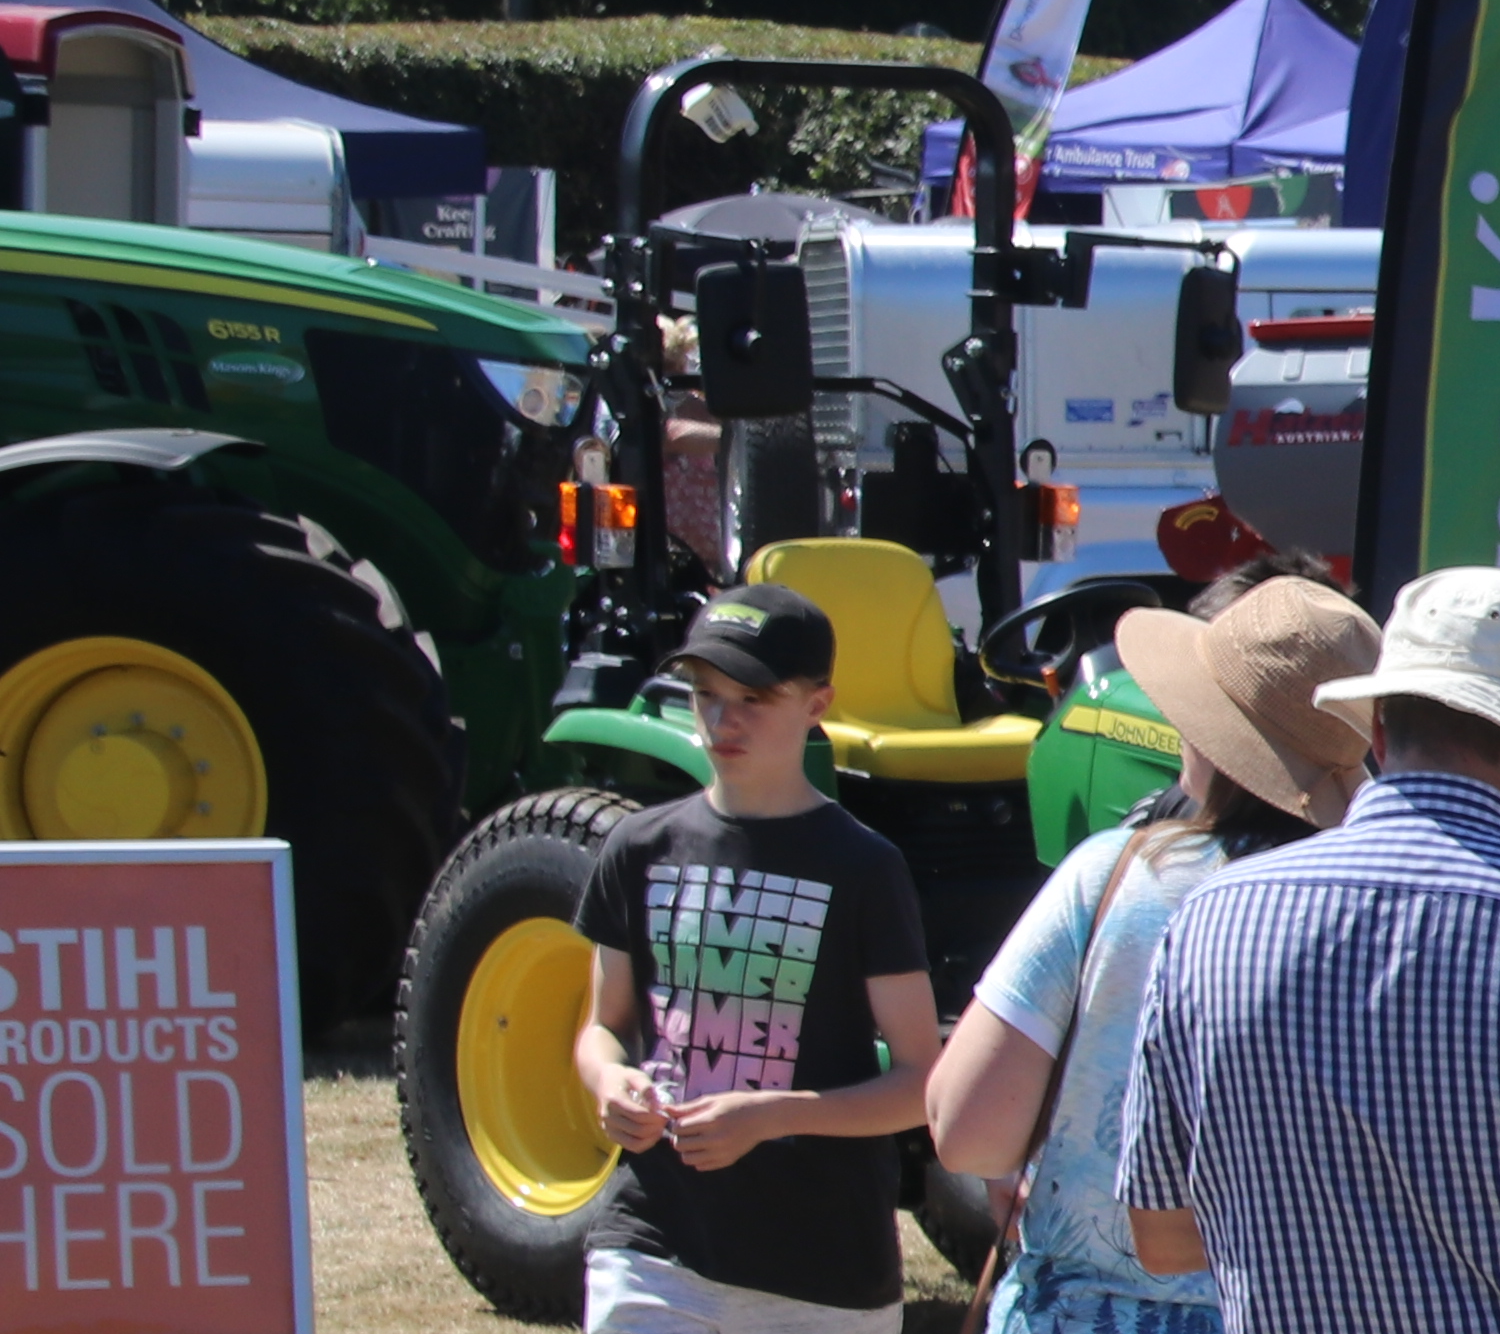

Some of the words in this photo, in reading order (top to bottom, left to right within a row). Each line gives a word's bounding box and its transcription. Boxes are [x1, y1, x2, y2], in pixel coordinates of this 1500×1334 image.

[1055, 145, 1123, 168] Ambulance
[1124, 147, 1157, 170] Trust
[436, 204, 476, 223] Kee
[0, 1017, 240, 1065] RODUCTS
